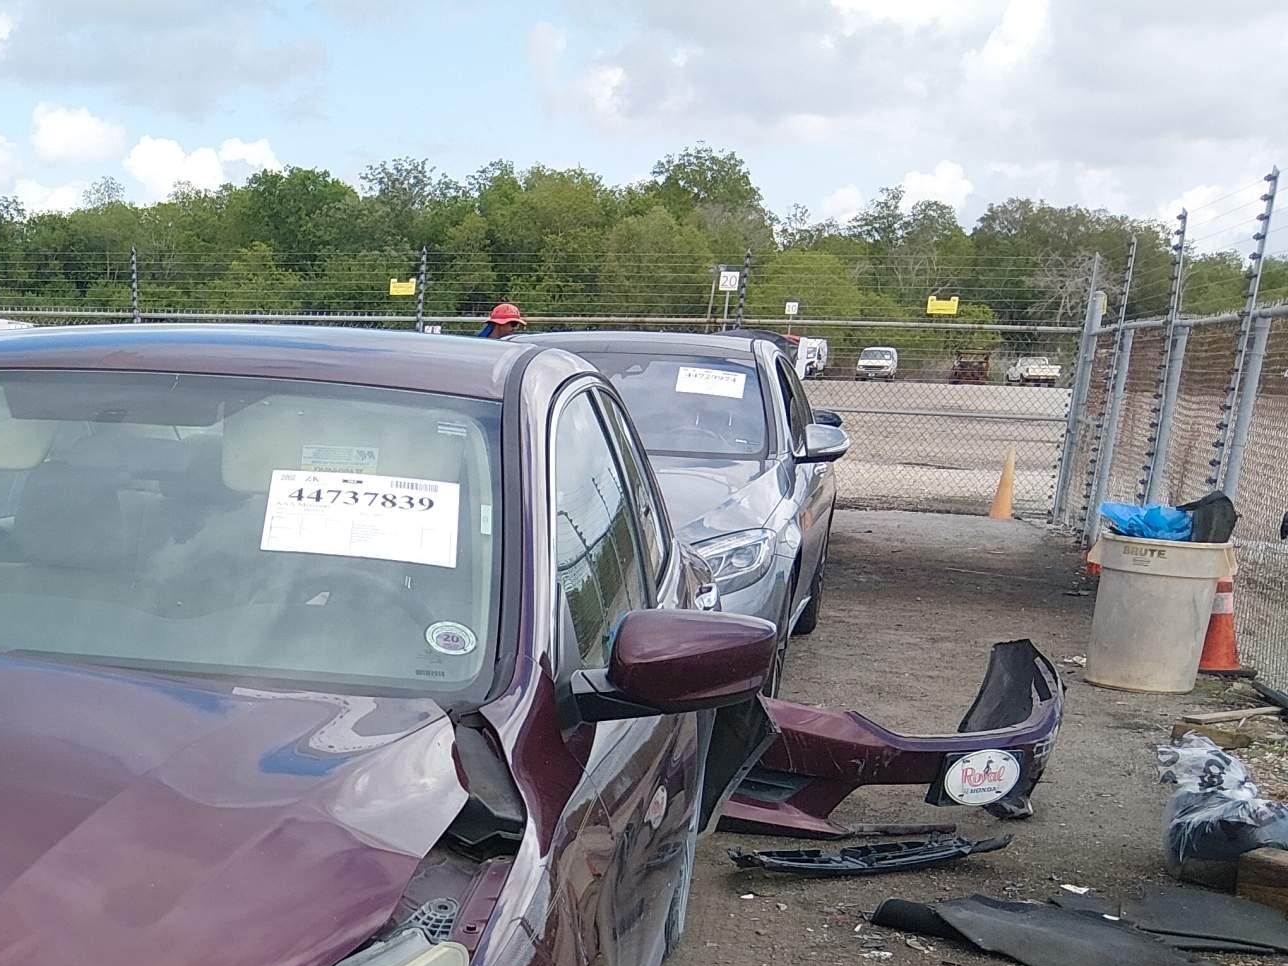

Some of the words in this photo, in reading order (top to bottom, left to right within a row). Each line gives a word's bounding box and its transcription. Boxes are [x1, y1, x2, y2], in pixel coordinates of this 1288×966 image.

[721, 275, 738, 288] 20
[288, 487, 435, 512] 44737839
[1123, 545, 1168, 560] BRUTE
[443, 634, 460, 643] 20
[961, 765, 1006, 787] Royal
[969, 786, 997, 794] HONDA
